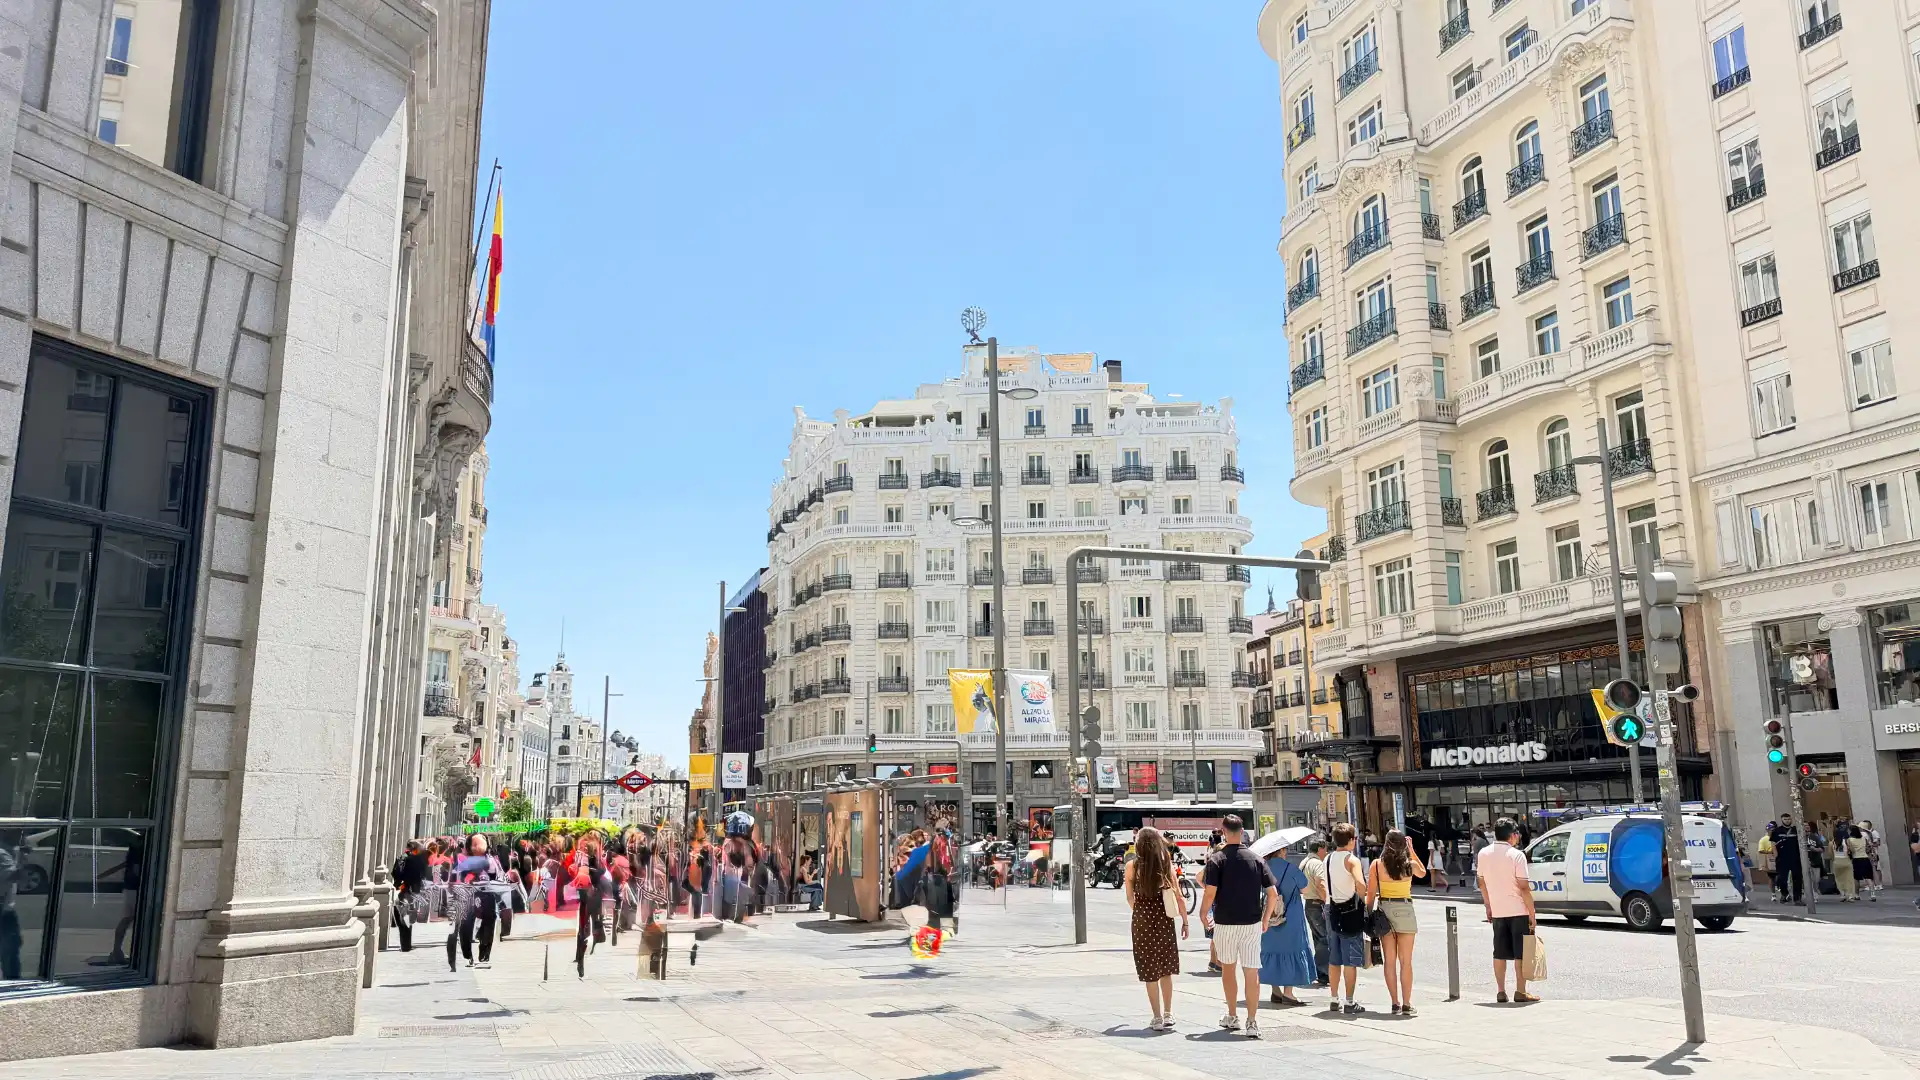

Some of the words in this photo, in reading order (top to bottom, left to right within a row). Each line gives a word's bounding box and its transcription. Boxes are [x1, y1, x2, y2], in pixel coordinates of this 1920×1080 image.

[1430, 741, 1548, 767] McDonald's
[1173, 831, 1198, 840] nación
[1199, 832, 1209, 840] de
